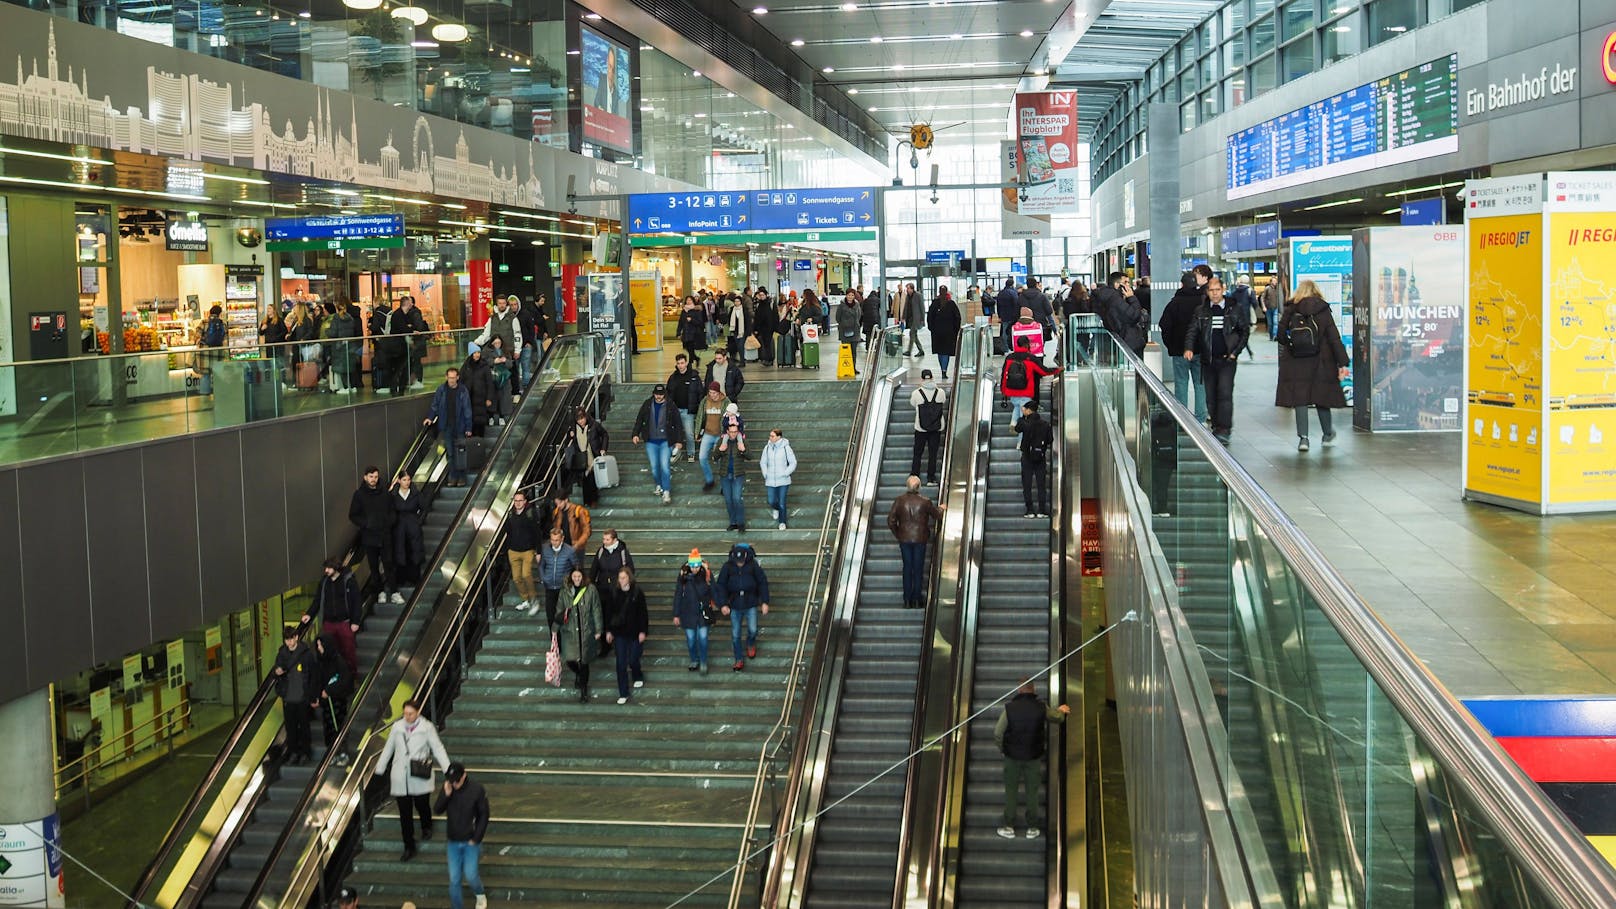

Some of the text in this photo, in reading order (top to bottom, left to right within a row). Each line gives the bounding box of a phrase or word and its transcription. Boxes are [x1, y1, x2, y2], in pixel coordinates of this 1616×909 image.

[1466, 62, 1577, 116] Ein Bahnhof der
[1049, 93, 1071, 105] IN
[1022, 116, 1067, 125] INTERSPAR
[1022, 125, 1060, 135] Flugblatt
[802, 196, 855, 205] Sonnwendgasse
[814, 216, 838, 225] Tickets
[1487, 231, 1531, 248] REGIOJET
[1354, 306, 1369, 326] PRAG
[1378, 303, 1459, 320] MÜNCHEN
[1082, 539, 1100, 547] HAV
